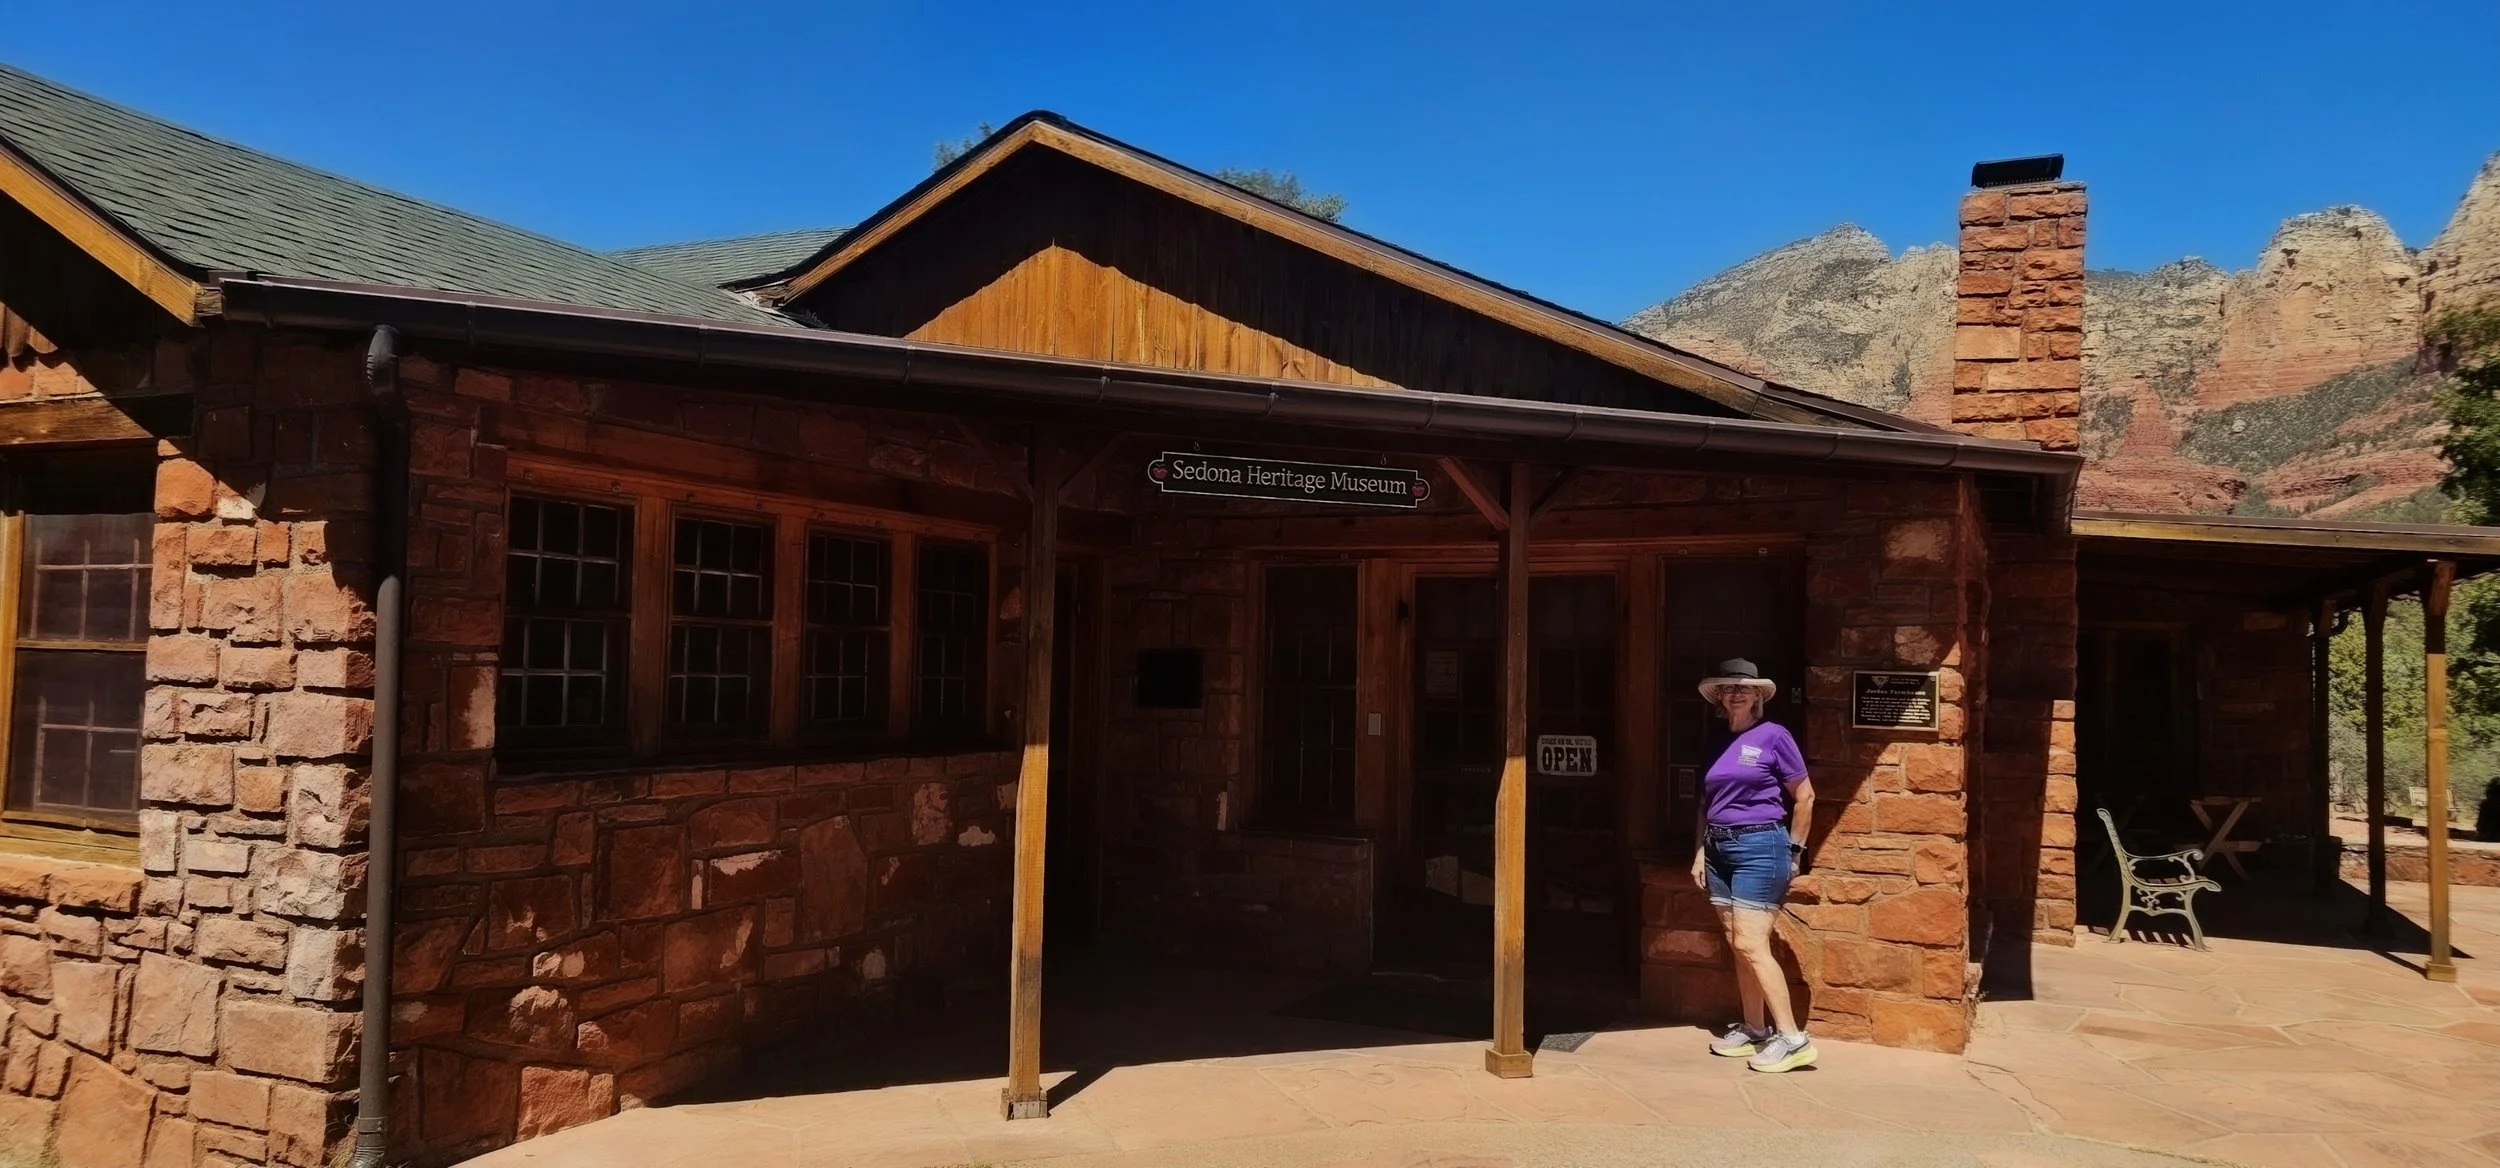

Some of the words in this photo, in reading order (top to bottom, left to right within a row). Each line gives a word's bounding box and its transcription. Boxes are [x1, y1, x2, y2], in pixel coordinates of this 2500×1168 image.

[1172, 460, 1242, 484] Sedona
[1247, 465, 1325, 494] Heritage
[1330, 472, 1407, 495] Museum
[1542, 746, 1592, 773] OPEN
